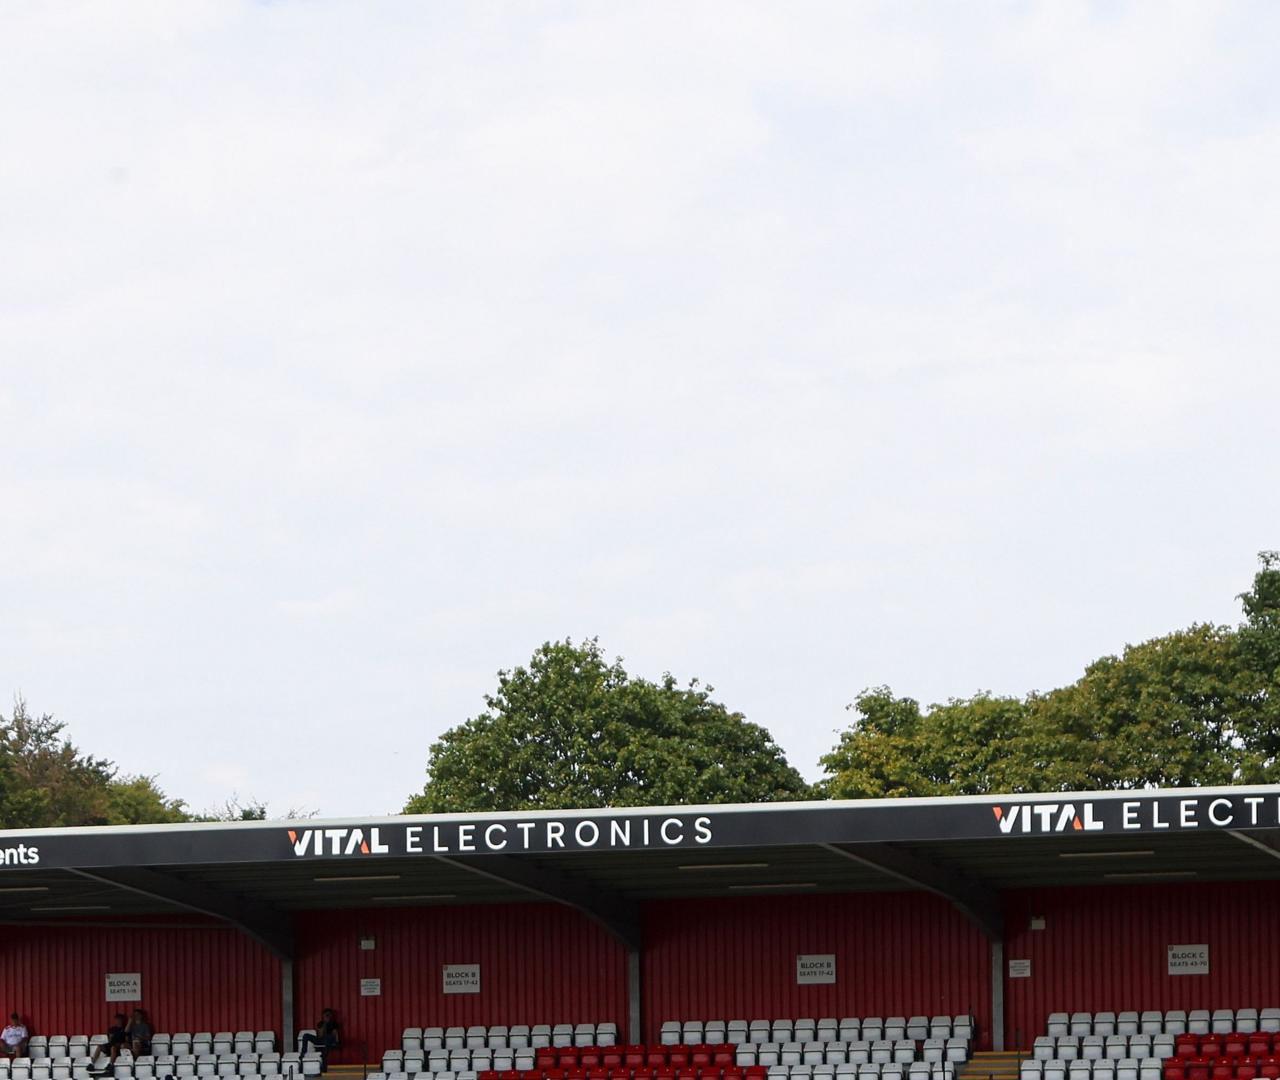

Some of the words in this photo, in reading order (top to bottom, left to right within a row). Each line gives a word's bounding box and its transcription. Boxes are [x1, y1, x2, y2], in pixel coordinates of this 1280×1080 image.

[287, 827, 389, 856] VITAL
[406, 816, 713, 853] ELECTRONICS
[993, 803, 1104, 834] VITAL
